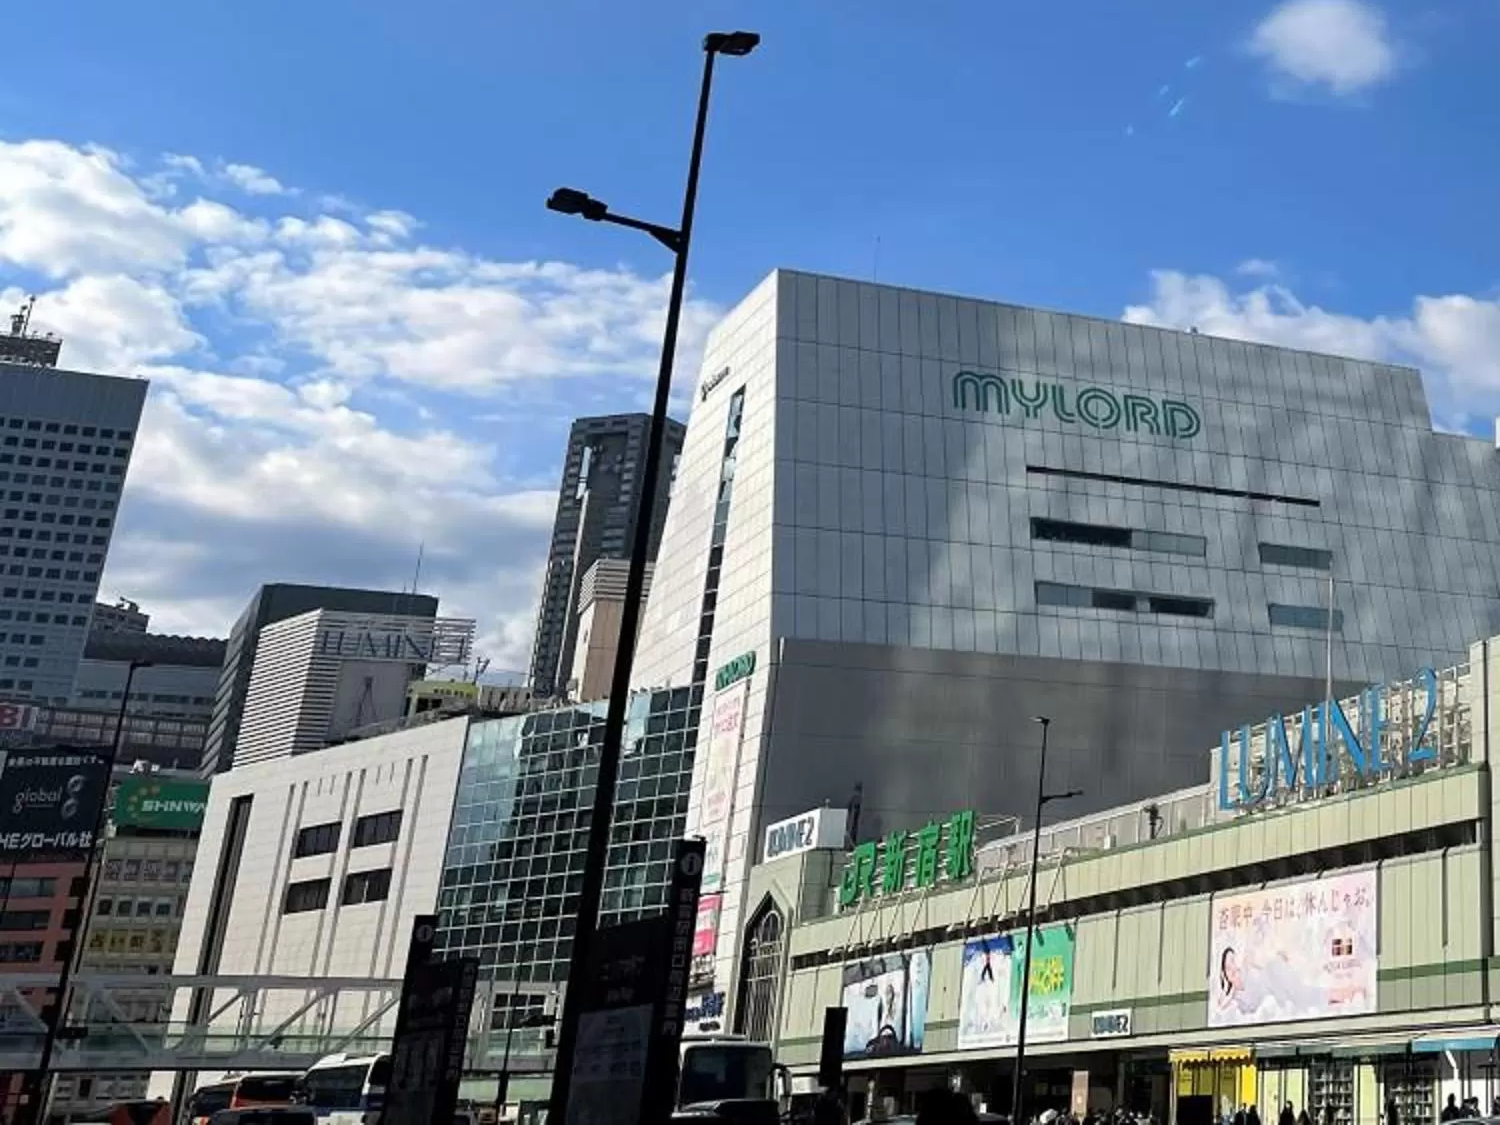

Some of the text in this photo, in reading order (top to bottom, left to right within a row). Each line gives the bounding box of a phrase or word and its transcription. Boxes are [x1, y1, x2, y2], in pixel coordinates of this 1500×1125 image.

[953, 370, 1201, 440] MYLORD
[1220, 666, 1438, 811] LUMINE 2
[12, 785, 63, 816] global
